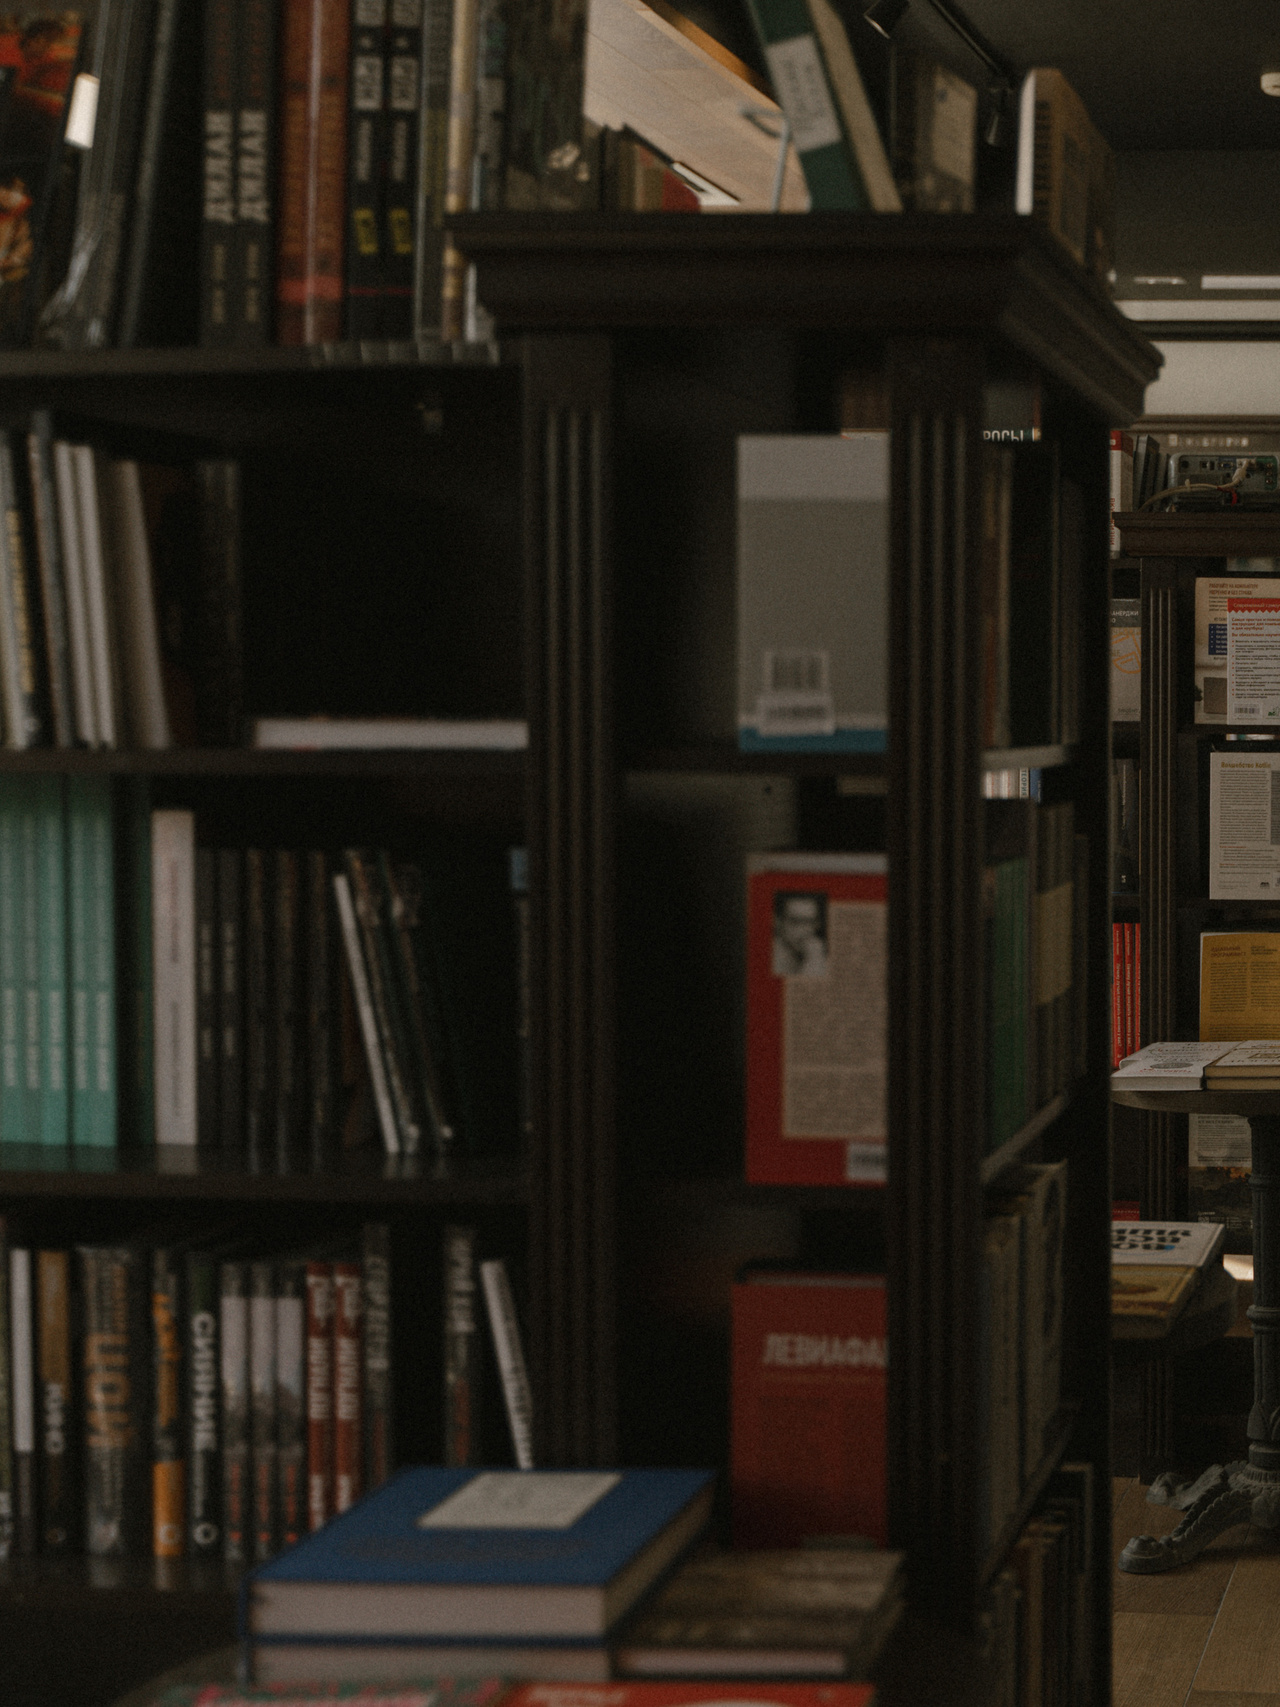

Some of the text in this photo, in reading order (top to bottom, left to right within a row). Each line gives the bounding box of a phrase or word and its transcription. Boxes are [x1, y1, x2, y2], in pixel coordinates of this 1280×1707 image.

[204, 109, 234, 225] ДИЛАН
[238, 109, 270, 225] ДИЛАН
[83, 1331, 137, 1450] ЦОЙ
[192, 1311, 218, 1453] СИЯНИЕ
[762, 1334, 889, 1367] ЛЕВИАФА
[43, 1381, 65, 1456] КИНО
